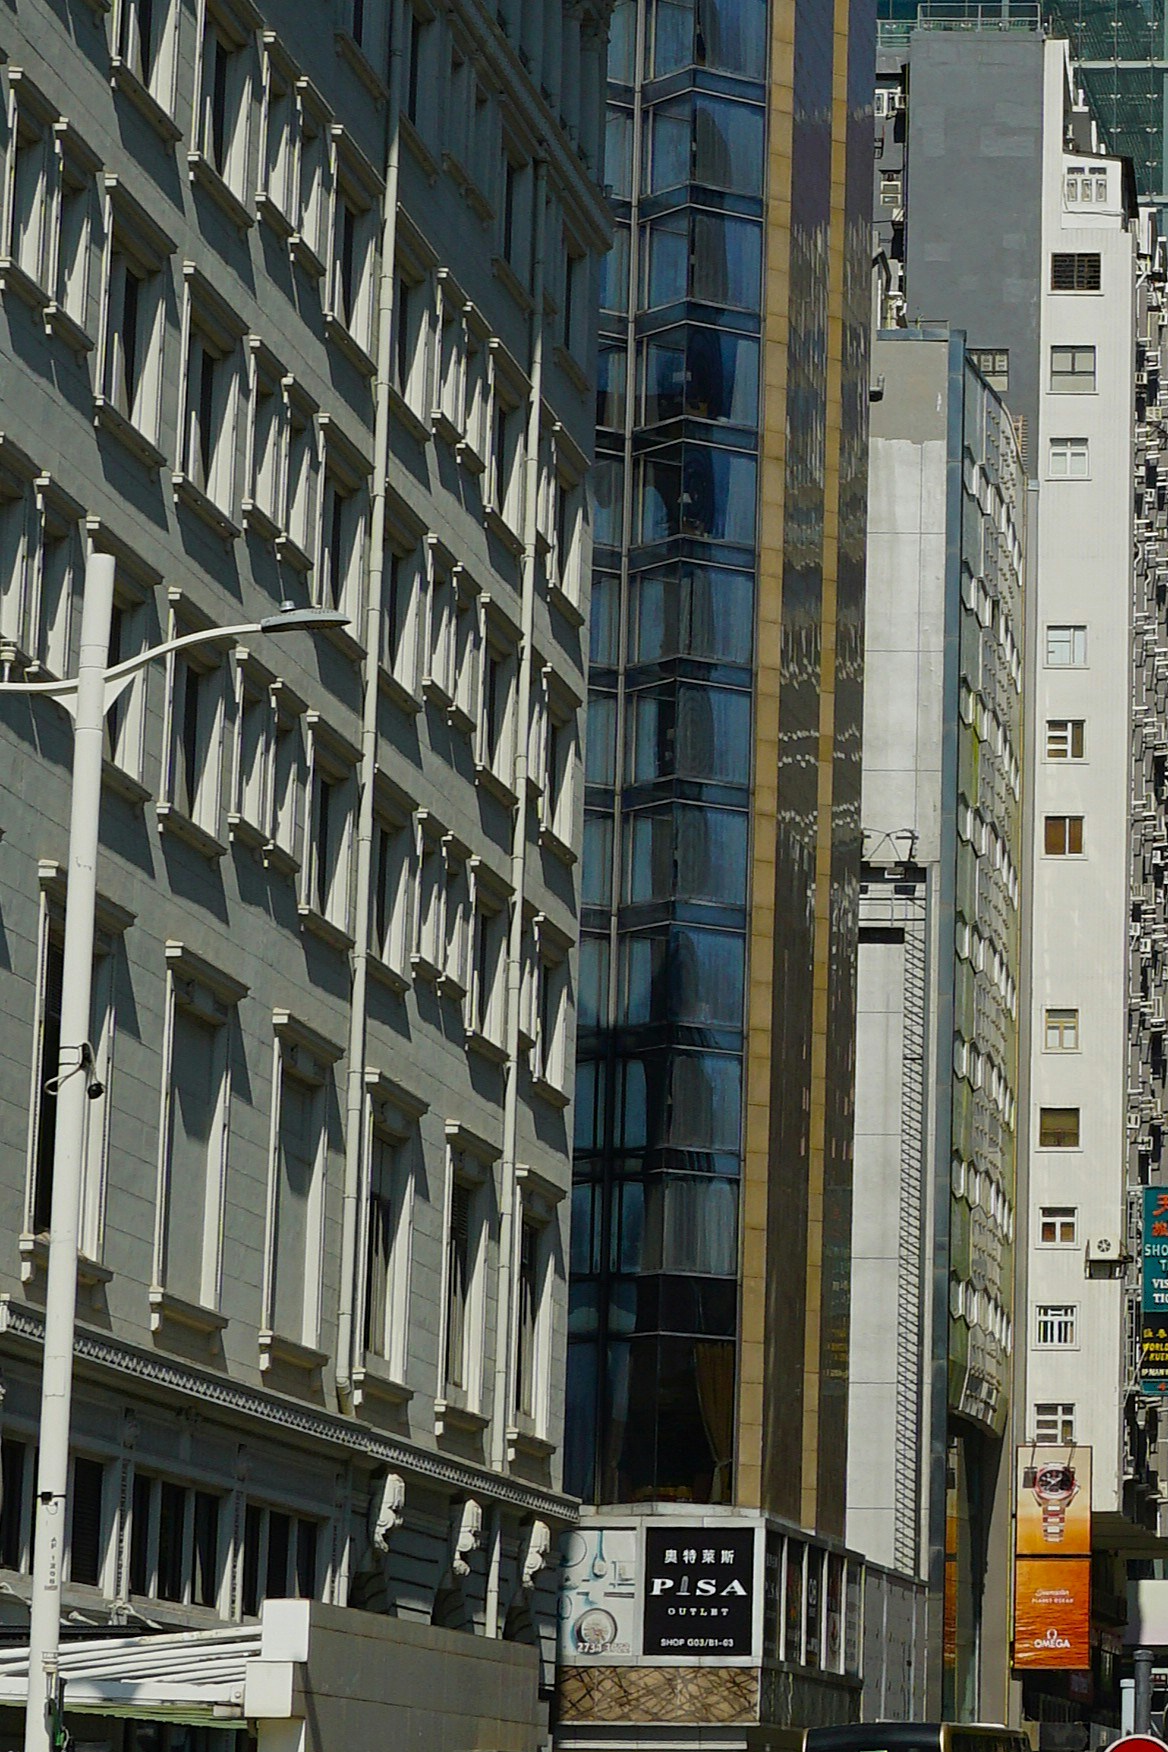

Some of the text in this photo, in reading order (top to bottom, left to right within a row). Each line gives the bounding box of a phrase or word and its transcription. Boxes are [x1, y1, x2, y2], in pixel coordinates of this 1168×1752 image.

[649, 1575, 748, 1596] PISA
[667, 1607, 729, 1616] OUTLET
[660, 1638, 685, 1647] SHOP
[1034, 1638, 1071, 1649] OMEGA
